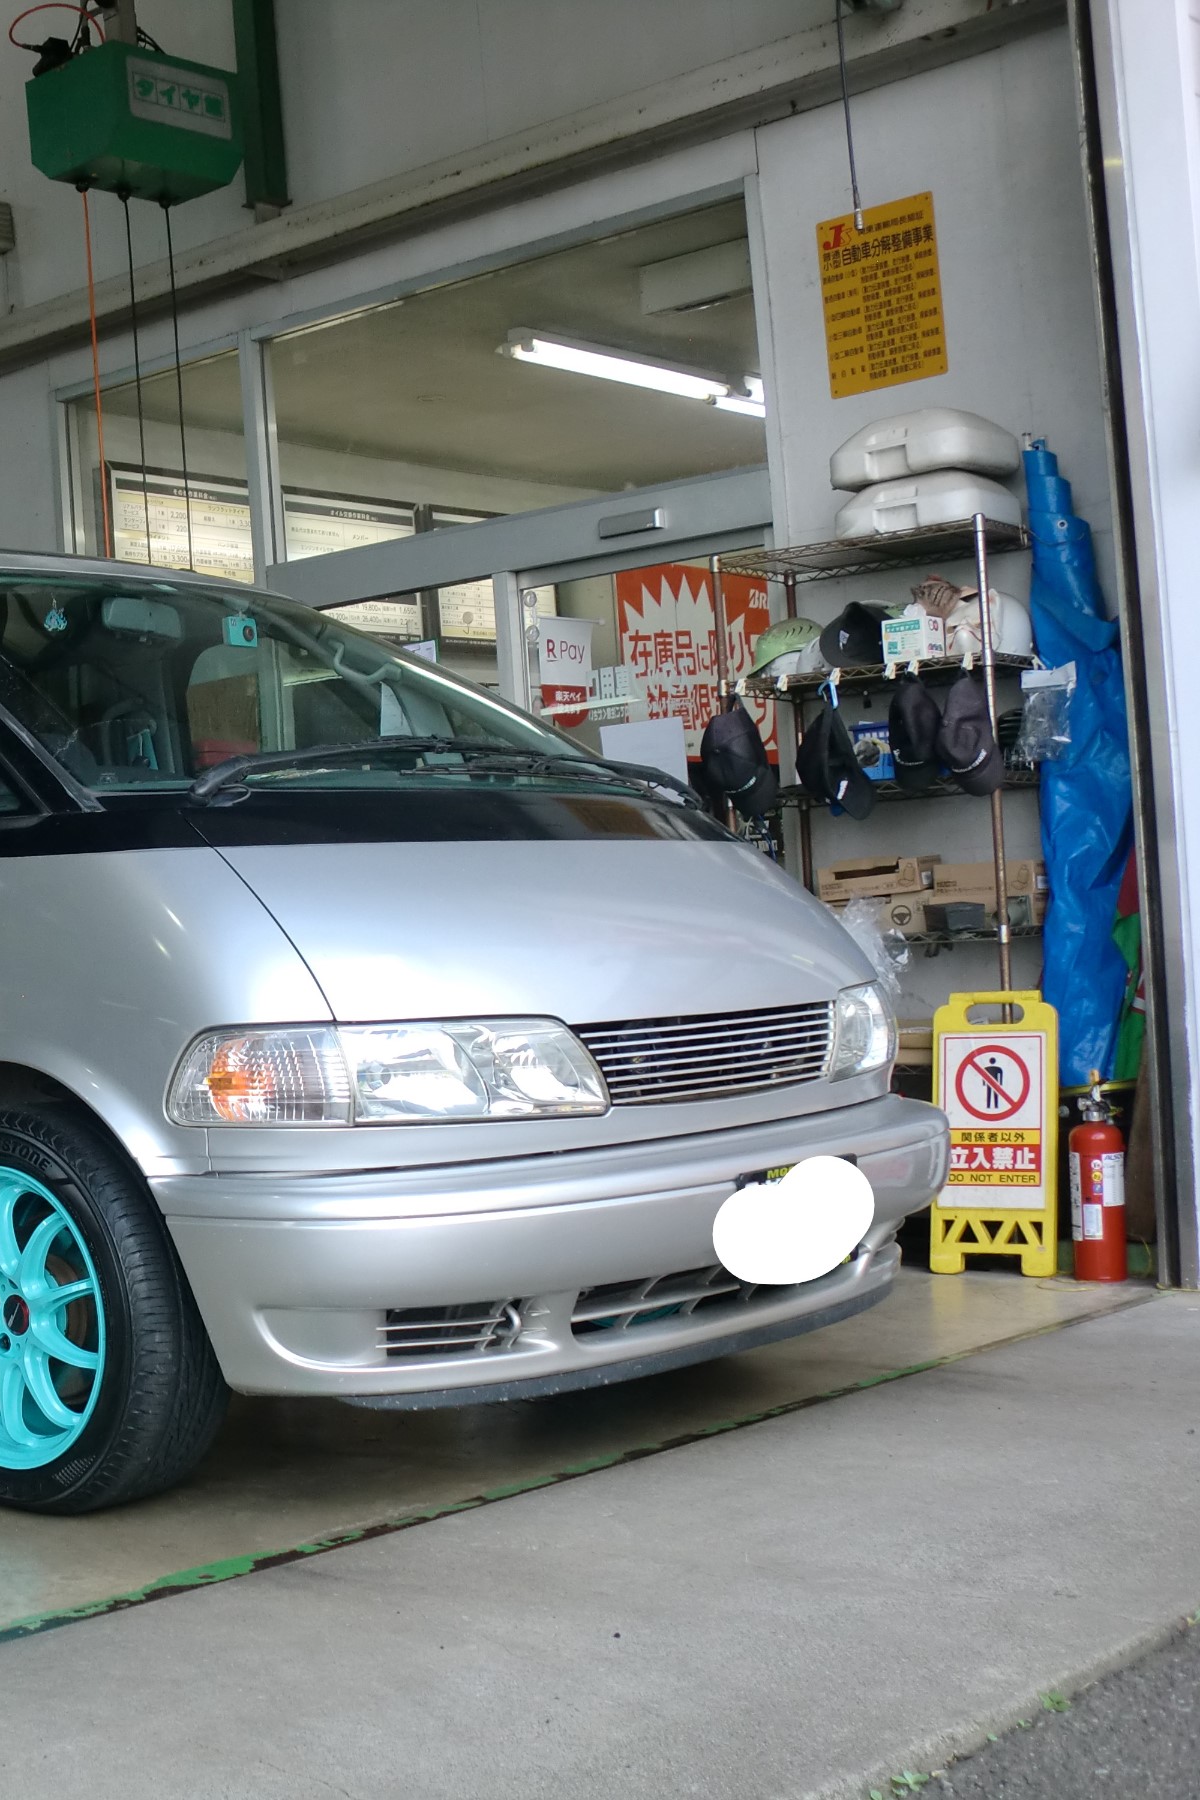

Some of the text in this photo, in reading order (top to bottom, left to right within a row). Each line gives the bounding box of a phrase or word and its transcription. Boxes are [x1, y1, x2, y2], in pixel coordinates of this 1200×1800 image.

[560, 640, 585, 664] Pay
[961, 1132, 1025, 1143] 関係者以外
[950, 1147, 1037, 1170] 立入禁止
[970, 1174, 993, 1182] NOT
[999, 1174, 1036, 1183] ENTER
